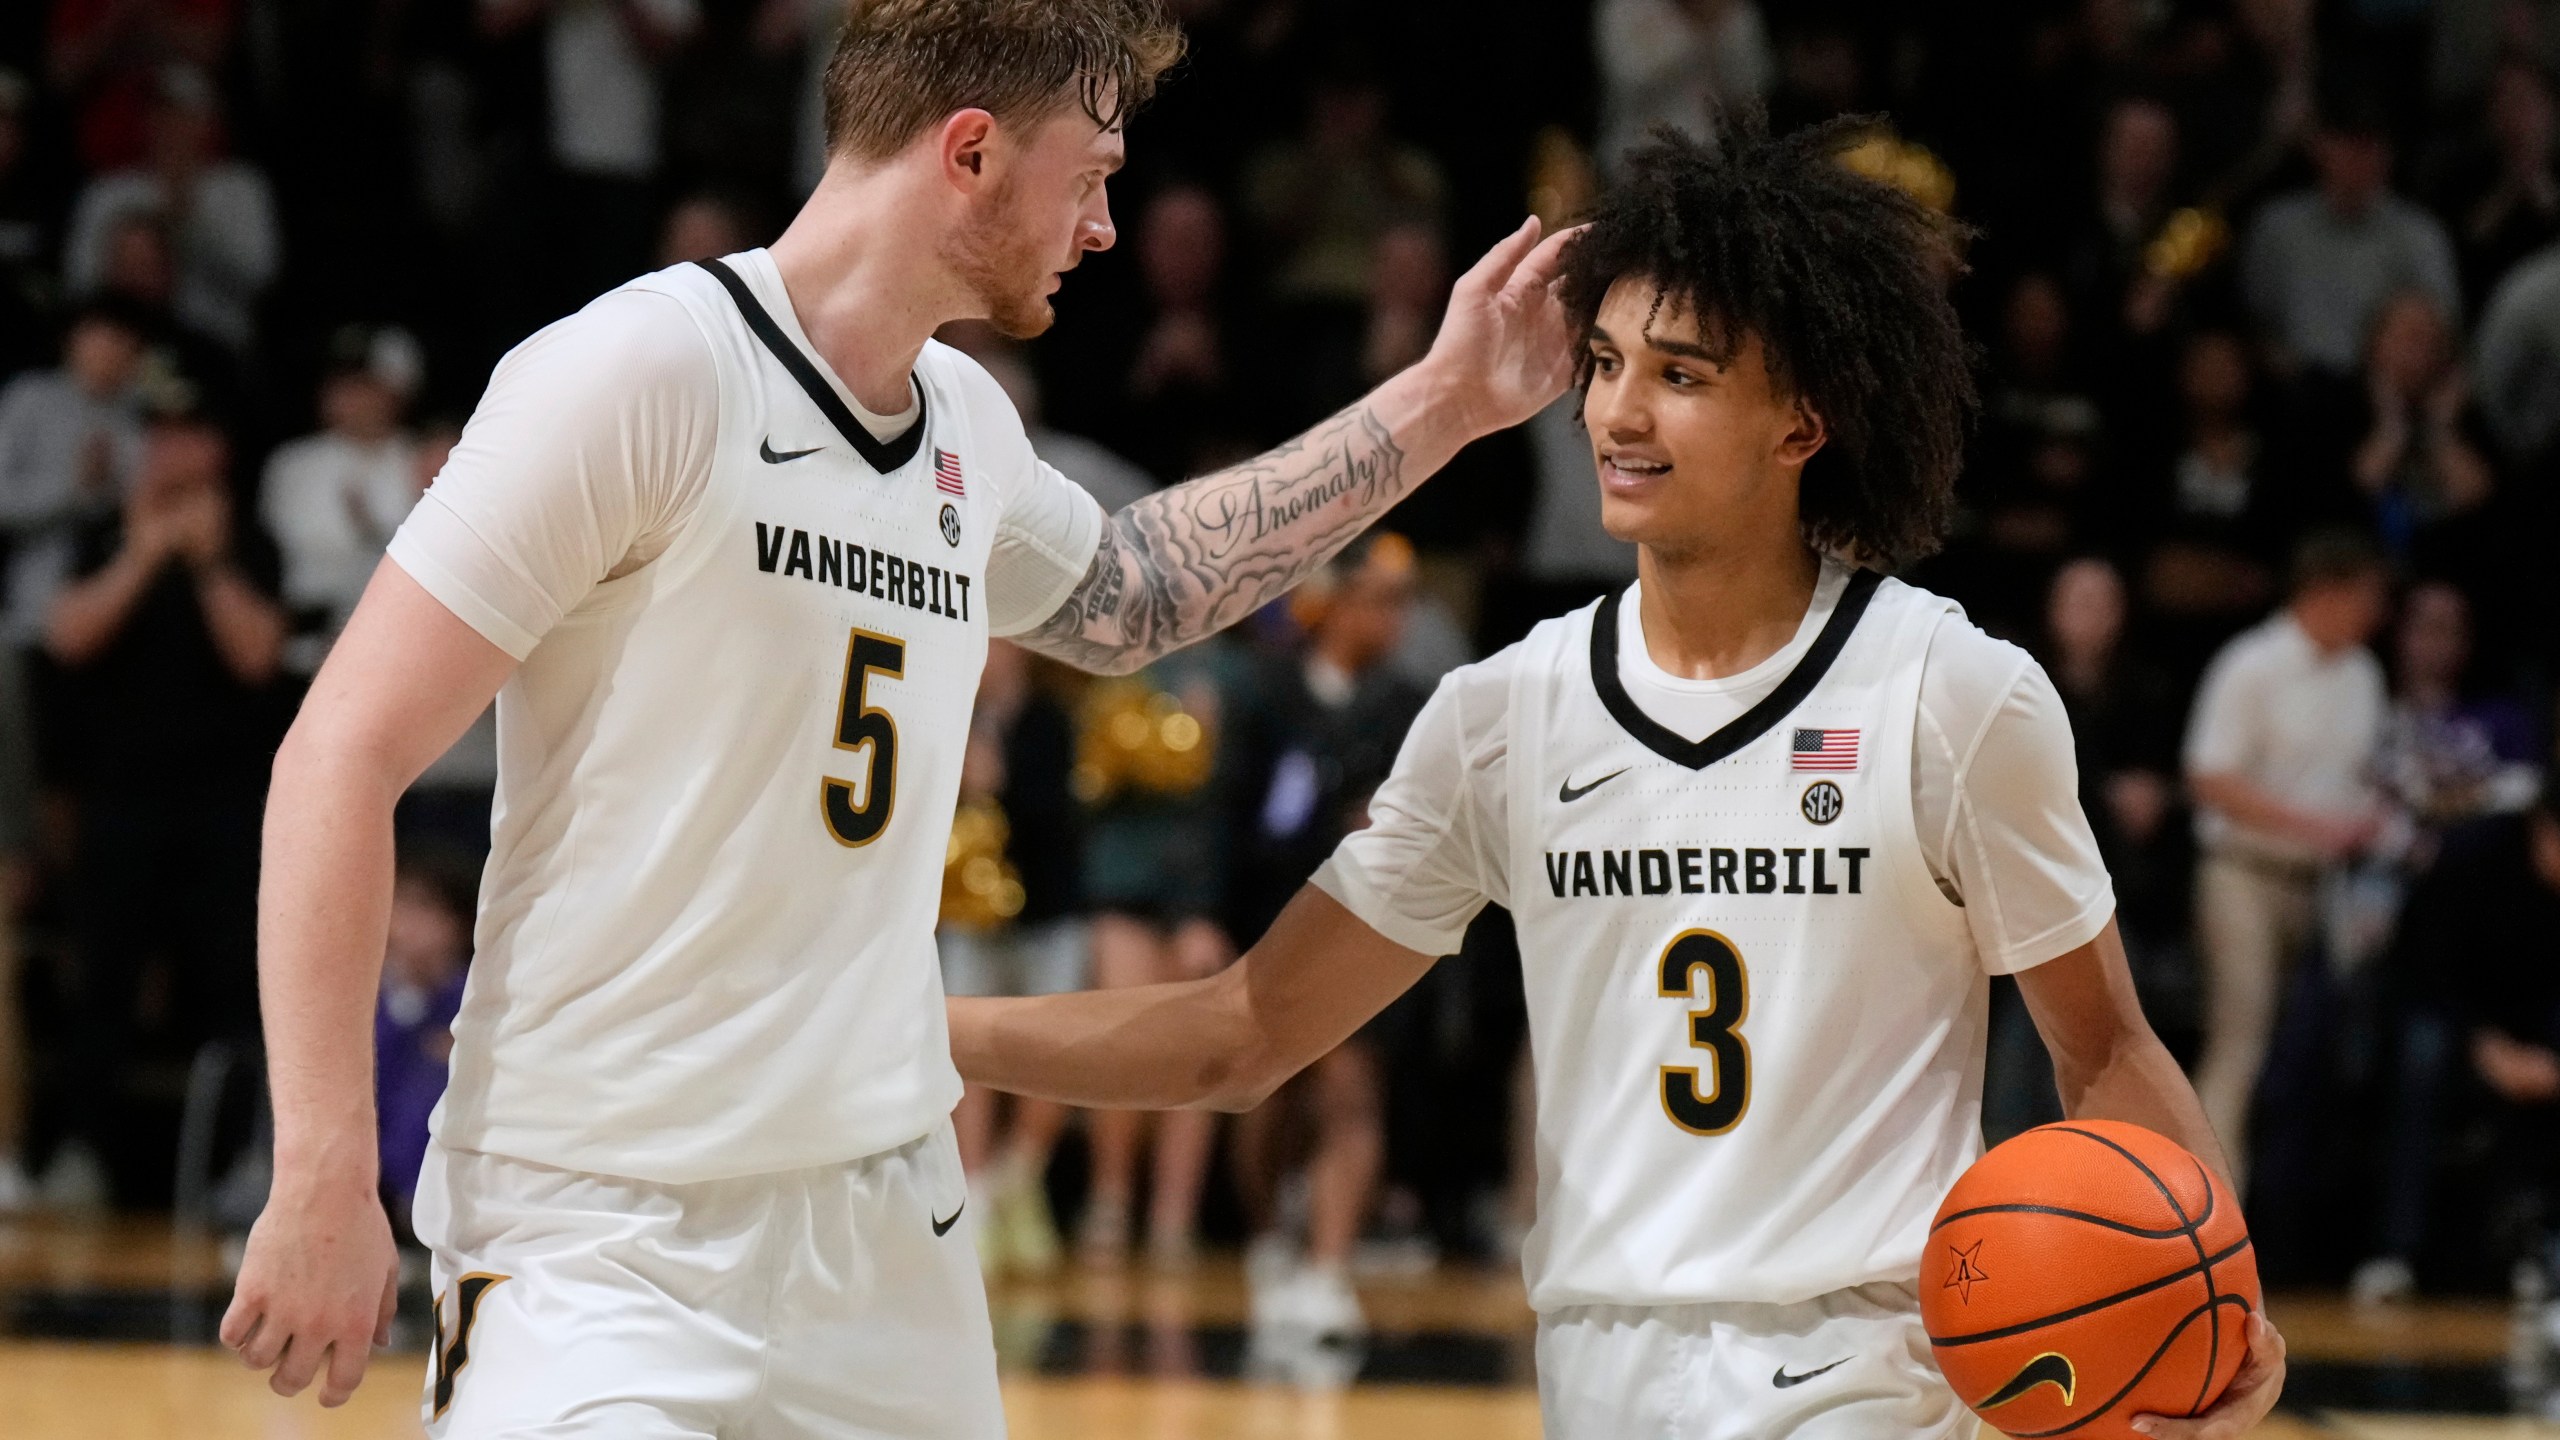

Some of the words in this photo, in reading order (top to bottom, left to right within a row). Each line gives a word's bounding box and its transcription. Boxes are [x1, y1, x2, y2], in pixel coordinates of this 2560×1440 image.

[940, 505, 961, 547] SEC
[1195, 434, 1382, 559] Anomaly
[755, 521, 971, 622] VANDERBILT
[820, 627, 906, 848] 5
[1803, 782, 1843, 824] SEC
[1545, 847, 1870, 897] VANDERBILT
[1658, 927, 1752, 1136] 3
